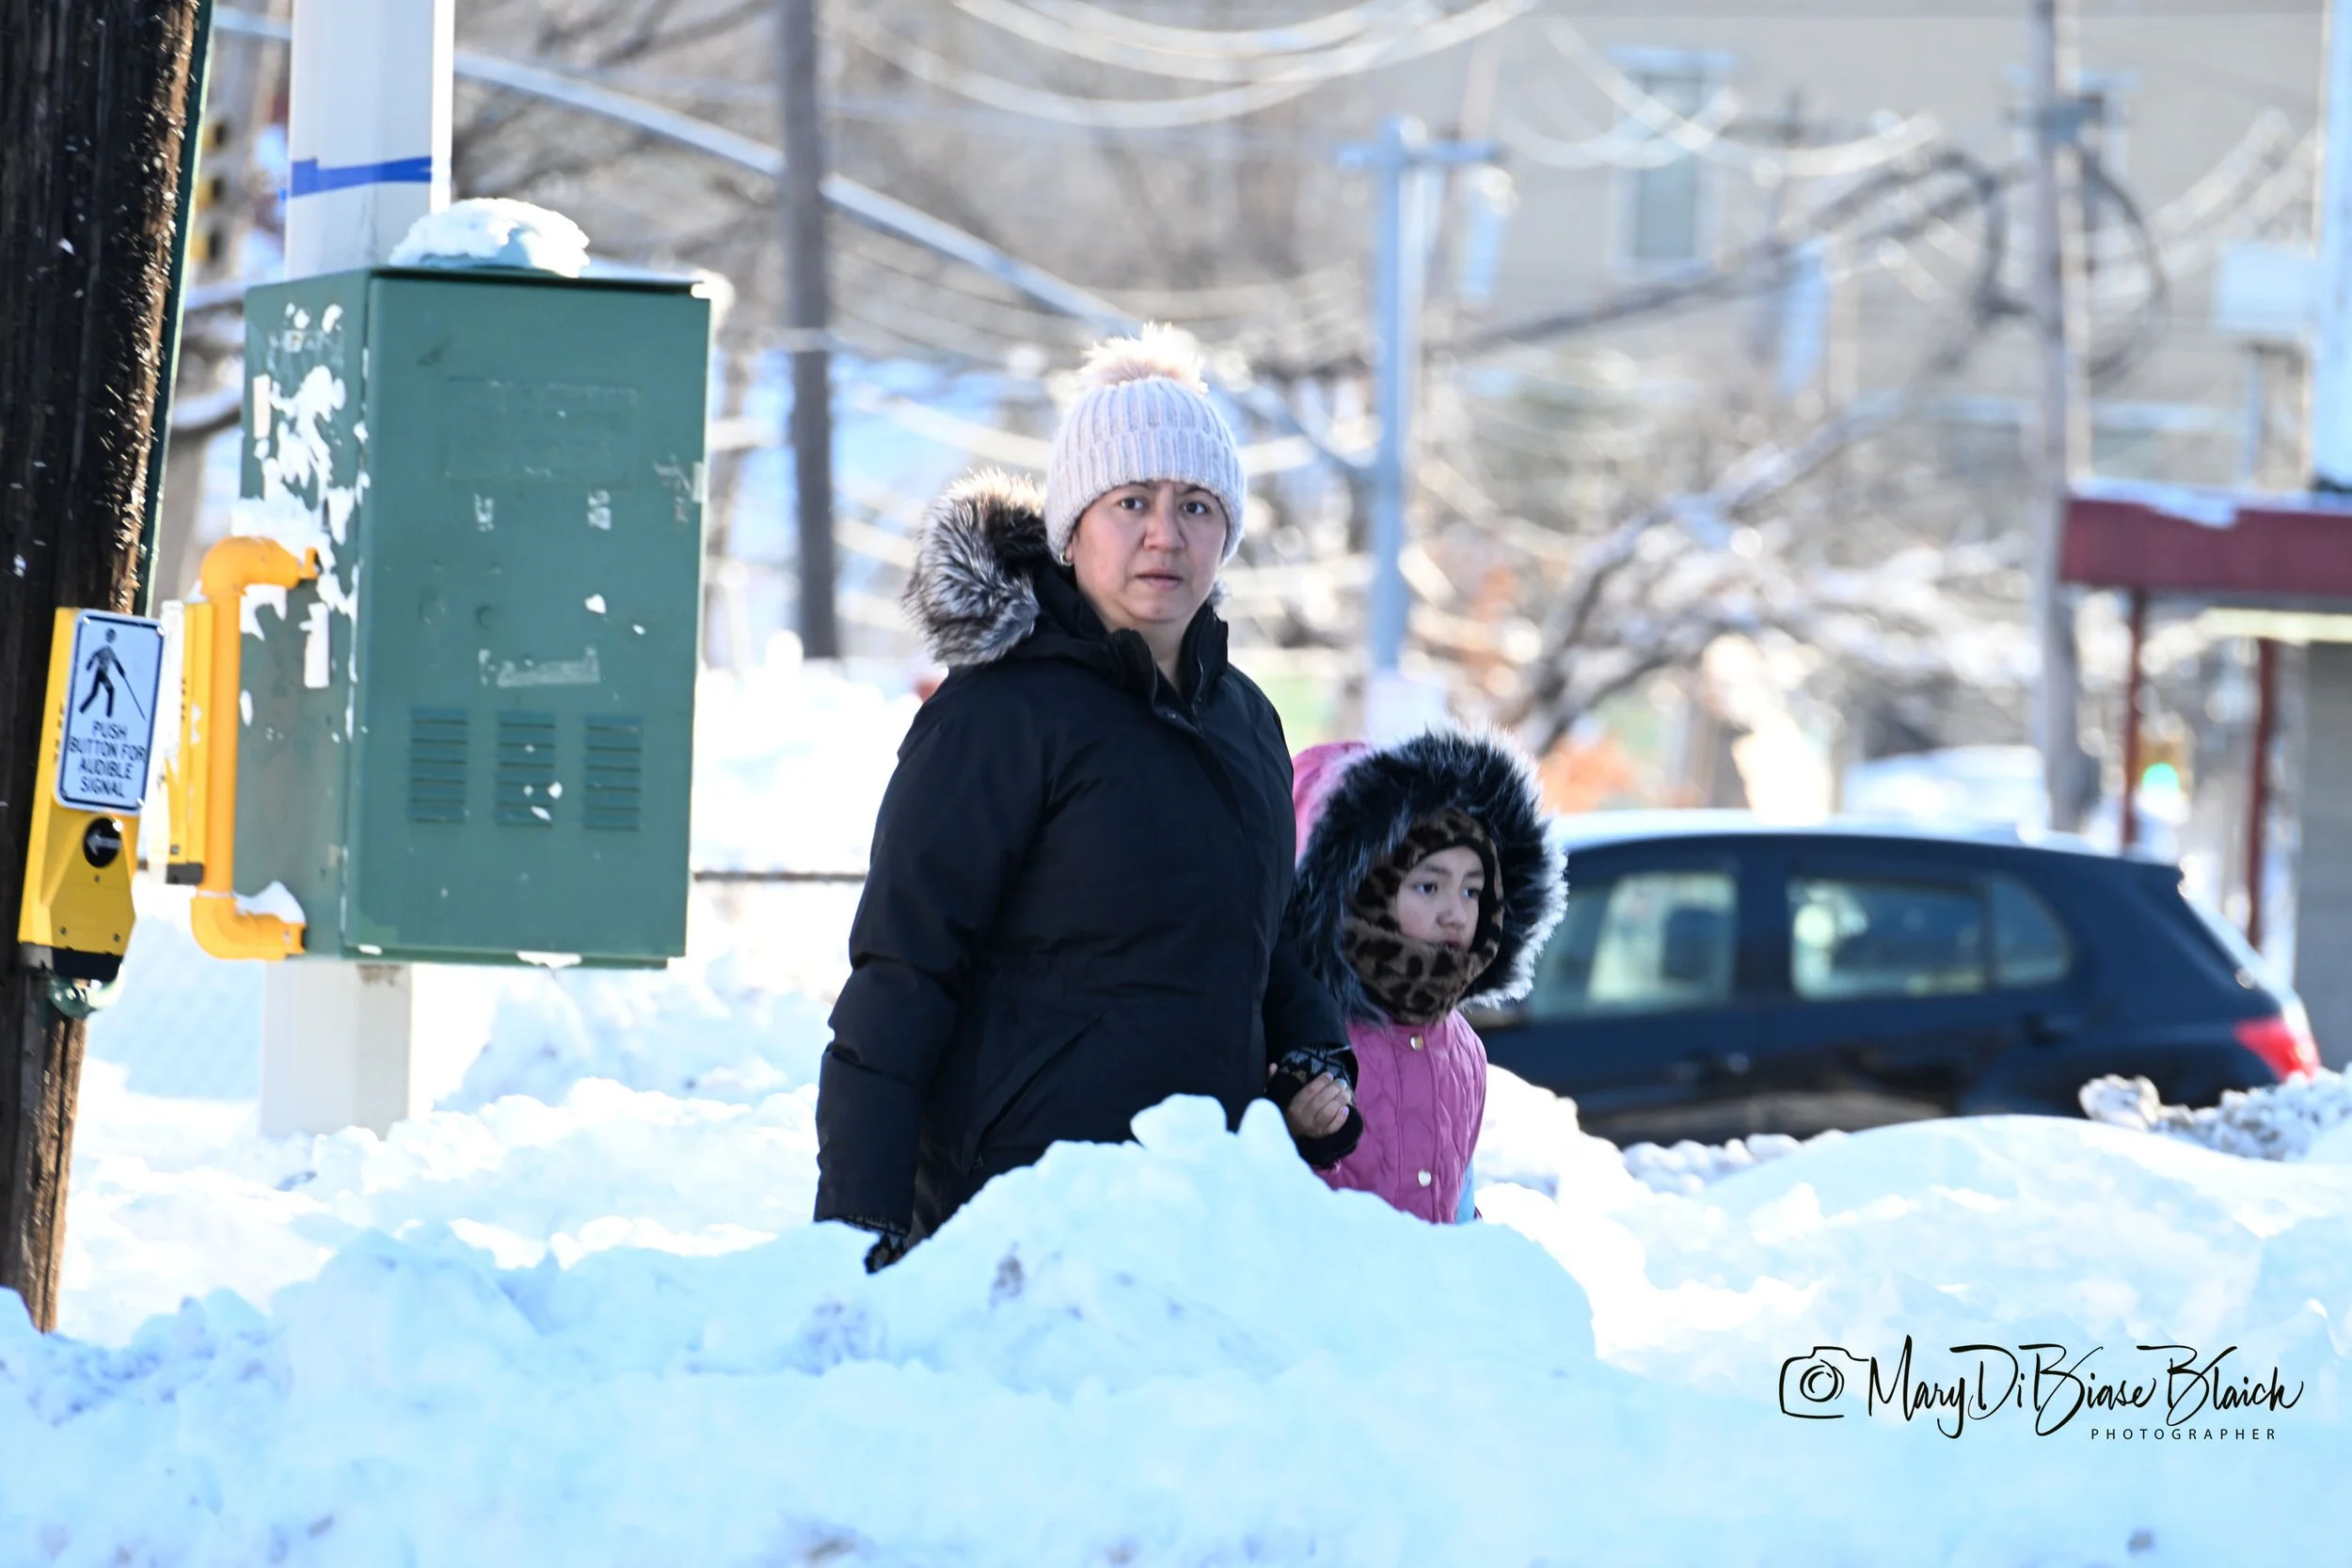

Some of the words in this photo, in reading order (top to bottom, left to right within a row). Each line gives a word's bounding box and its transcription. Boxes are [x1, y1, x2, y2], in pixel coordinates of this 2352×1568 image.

[92, 720, 128, 740] PUSH
[68, 736, 118, 757] BUTTON
[121, 743, 147, 762] FOR
[79, 757, 134, 780] AUDIBLE
[80, 776, 126, 799] SIGNAL
